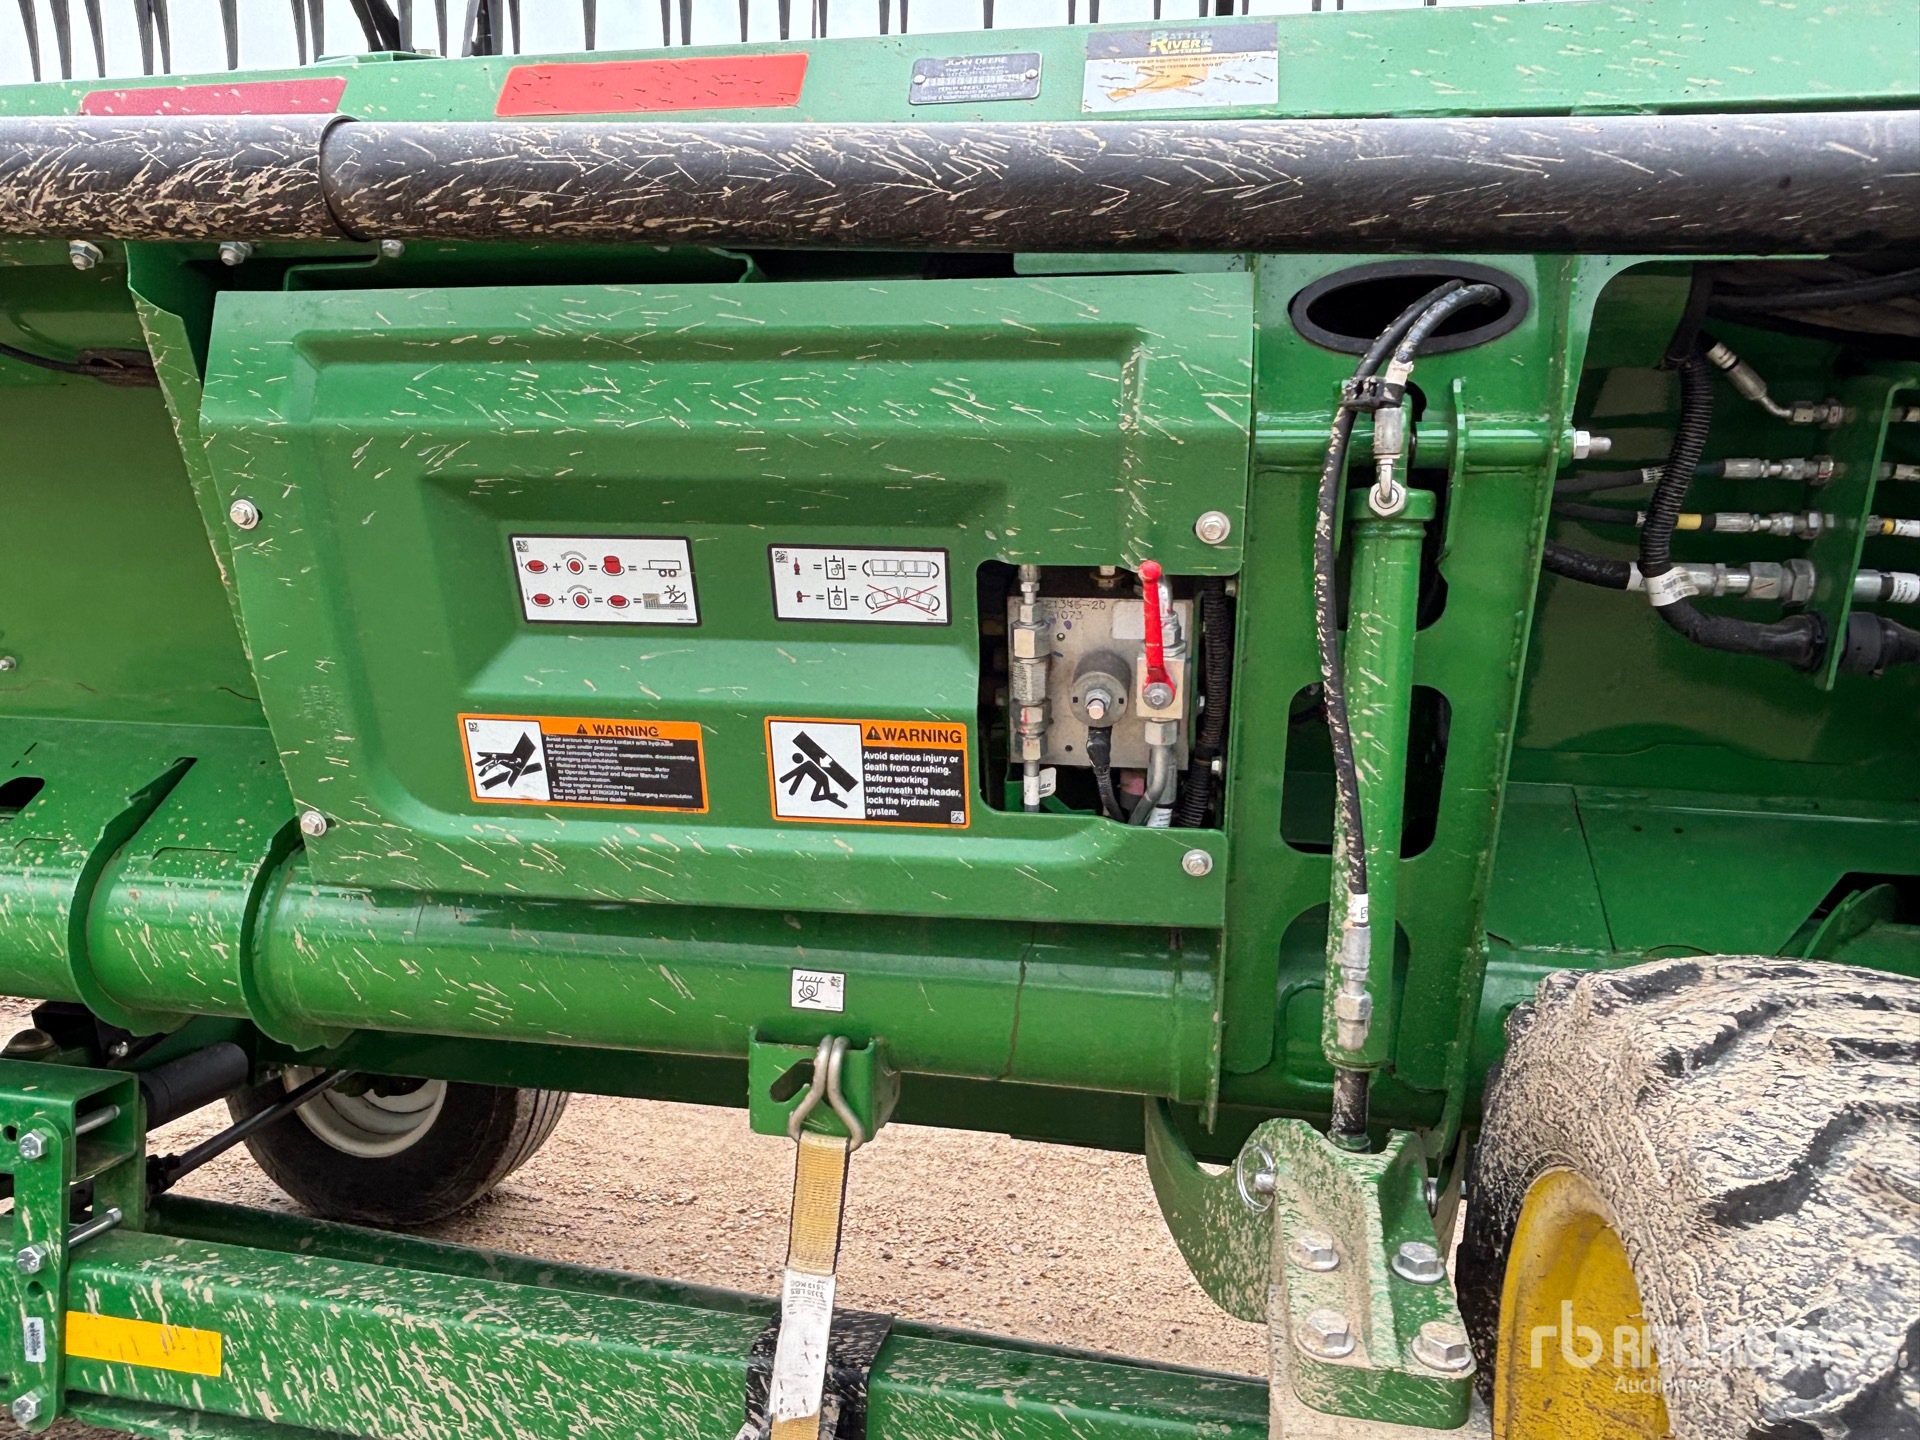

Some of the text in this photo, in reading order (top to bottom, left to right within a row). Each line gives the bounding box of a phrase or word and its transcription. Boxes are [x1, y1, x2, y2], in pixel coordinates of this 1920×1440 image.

[1150, 38, 1201, 54] RIVER
[592, 724, 658, 737] WARNING
[882, 728, 962, 744] WARNING
[864, 751, 888, 761] Avoid
[890, 753, 921, 762] serious
[923, 753, 948, 764] injury
[864, 763, 951, 775] death from crushing.
[865, 774, 928, 786] Before working
[865, 785, 961, 797] underneath the header,
[866, 795, 940, 807] lock the hydraulic
[867, 807, 899, 817] system.
